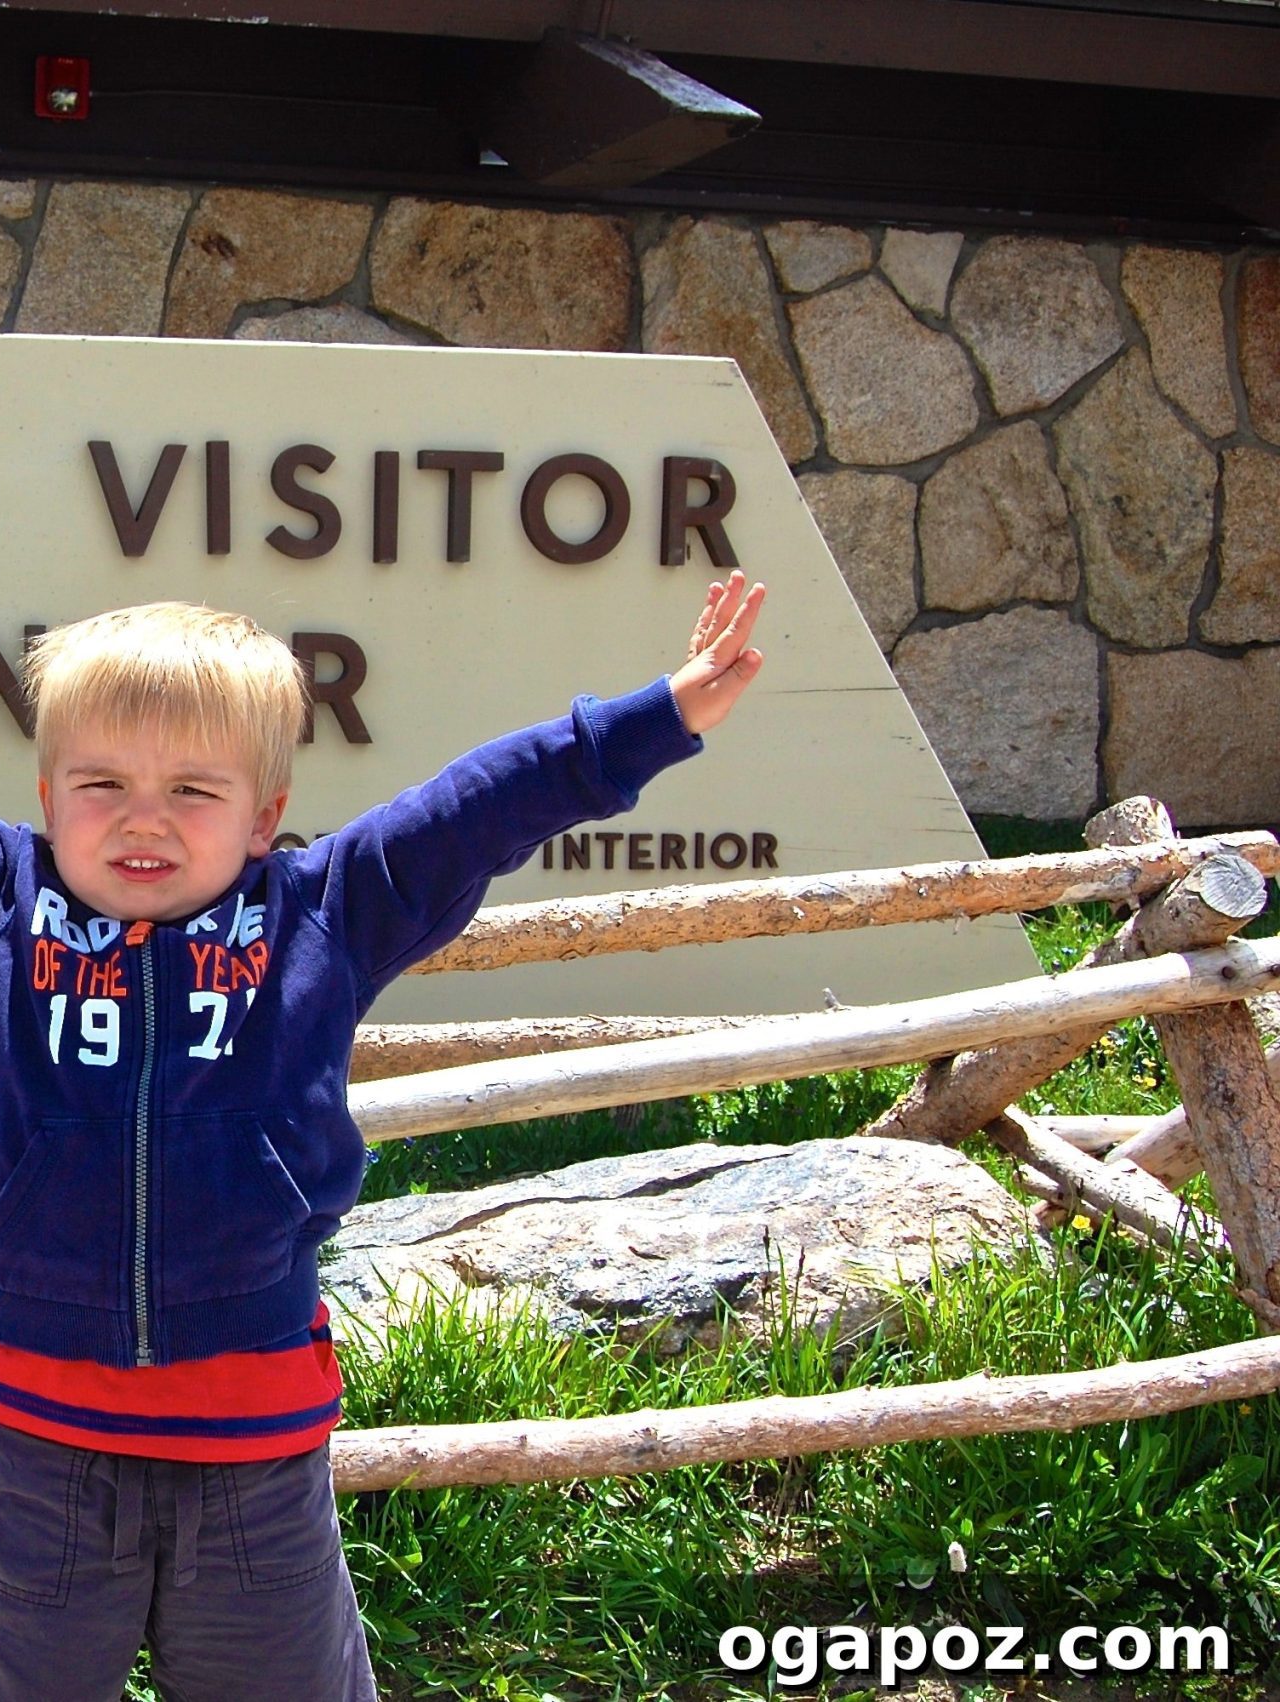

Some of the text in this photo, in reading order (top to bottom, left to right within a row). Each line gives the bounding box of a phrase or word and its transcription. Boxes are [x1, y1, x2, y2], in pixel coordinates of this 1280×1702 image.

[87, 440, 740, 567] VISITOR
[543, 831, 779, 870] INTERIOR
[33, 939, 268, 996] OF THE YEAR
